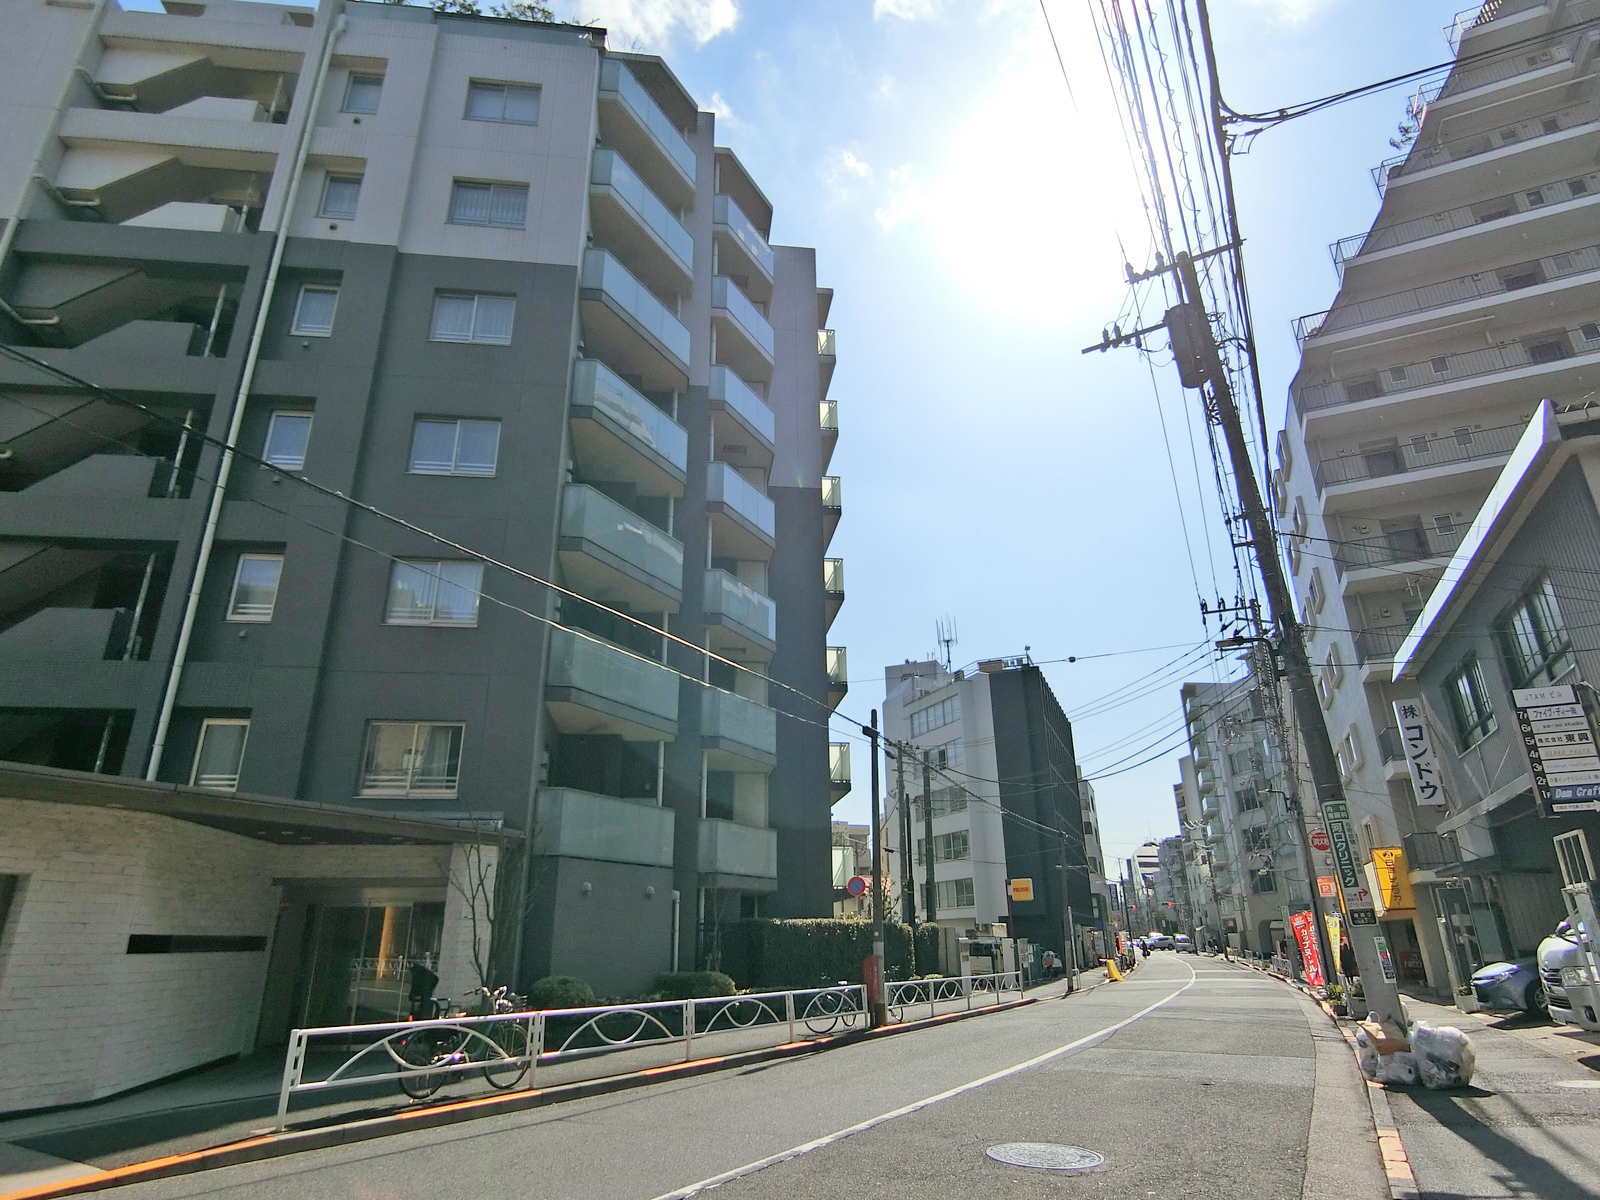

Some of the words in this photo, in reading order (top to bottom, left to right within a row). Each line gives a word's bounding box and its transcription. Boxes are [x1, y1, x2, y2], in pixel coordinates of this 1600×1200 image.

[1517, 711, 1528, 720] 7F
[1521, 723, 1532, 733] 6F
[1525, 737, 1536, 746] 5F
[1537, 736, 1563, 744] 株式会社
[1529, 750, 1539, 759] 4F
[1532, 763, 1543, 772] 3F
[1536, 776, 1547, 785] 2F
[1331, 822, 1355, 887] 河口クリニック
